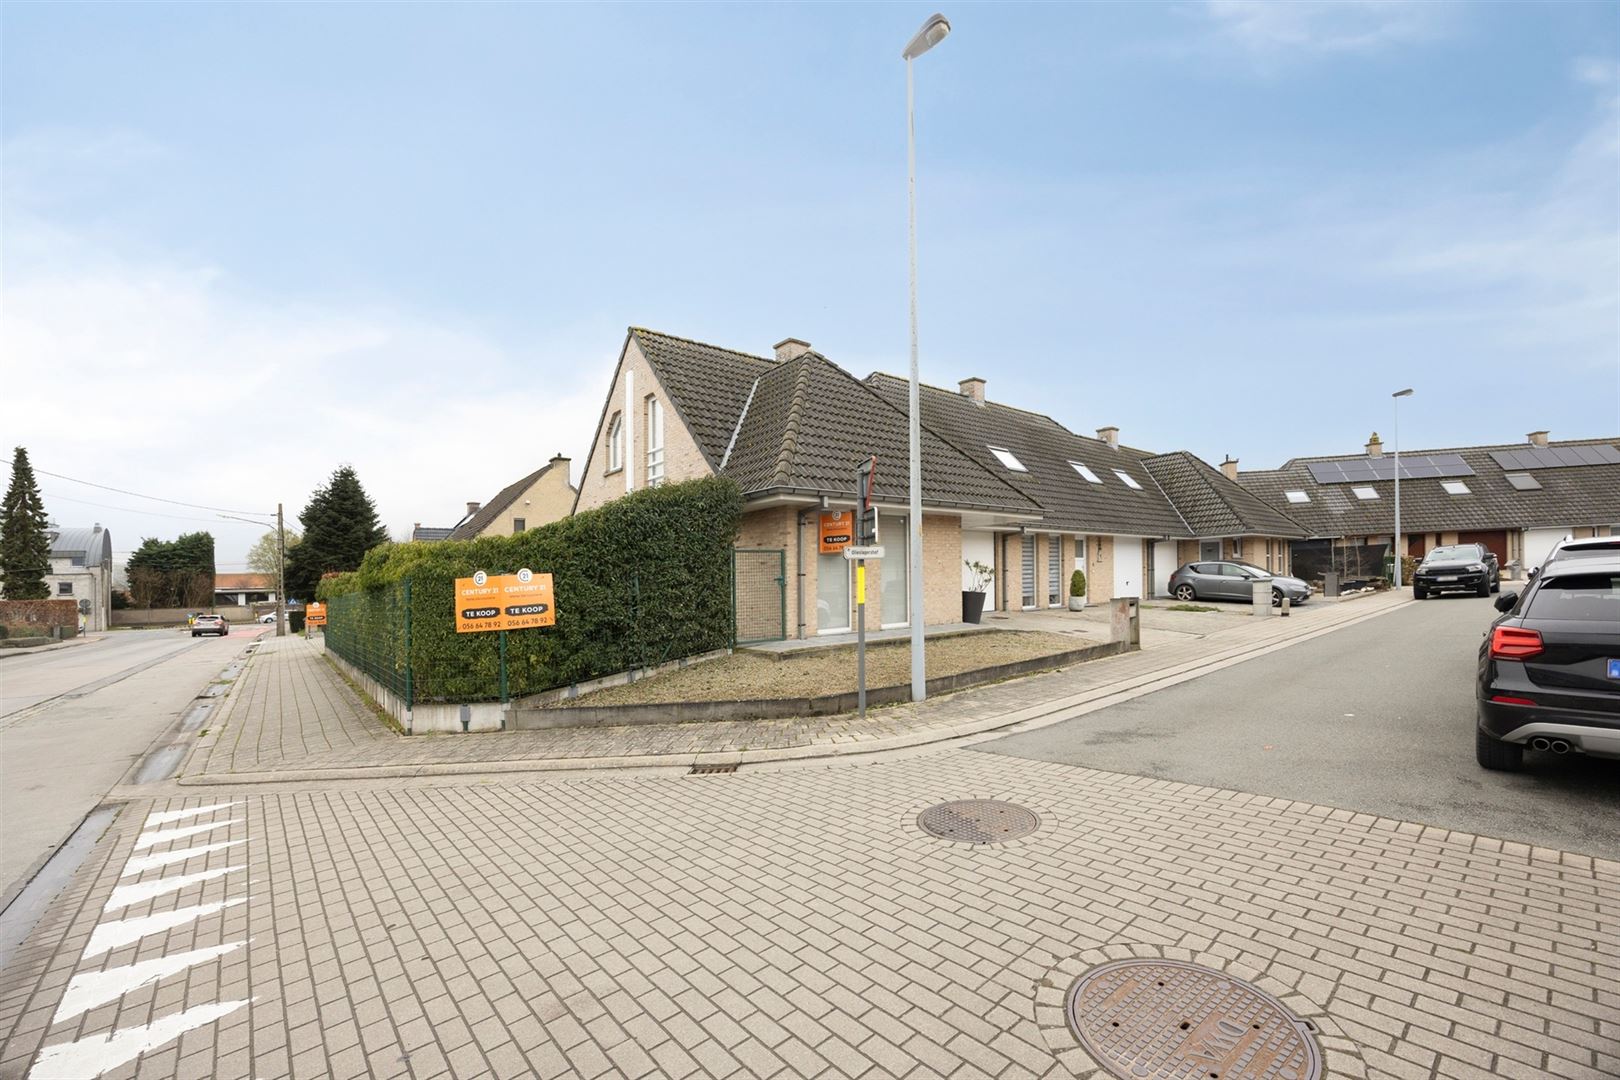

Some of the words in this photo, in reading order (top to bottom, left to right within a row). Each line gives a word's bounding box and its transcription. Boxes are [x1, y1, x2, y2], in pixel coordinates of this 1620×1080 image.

[462, 588, 491, 596] CENTURY
[504, 585, 537, 593] CENTURY
[521, 618, 529, 626] 64
[539, 616, 547, 624] 92
